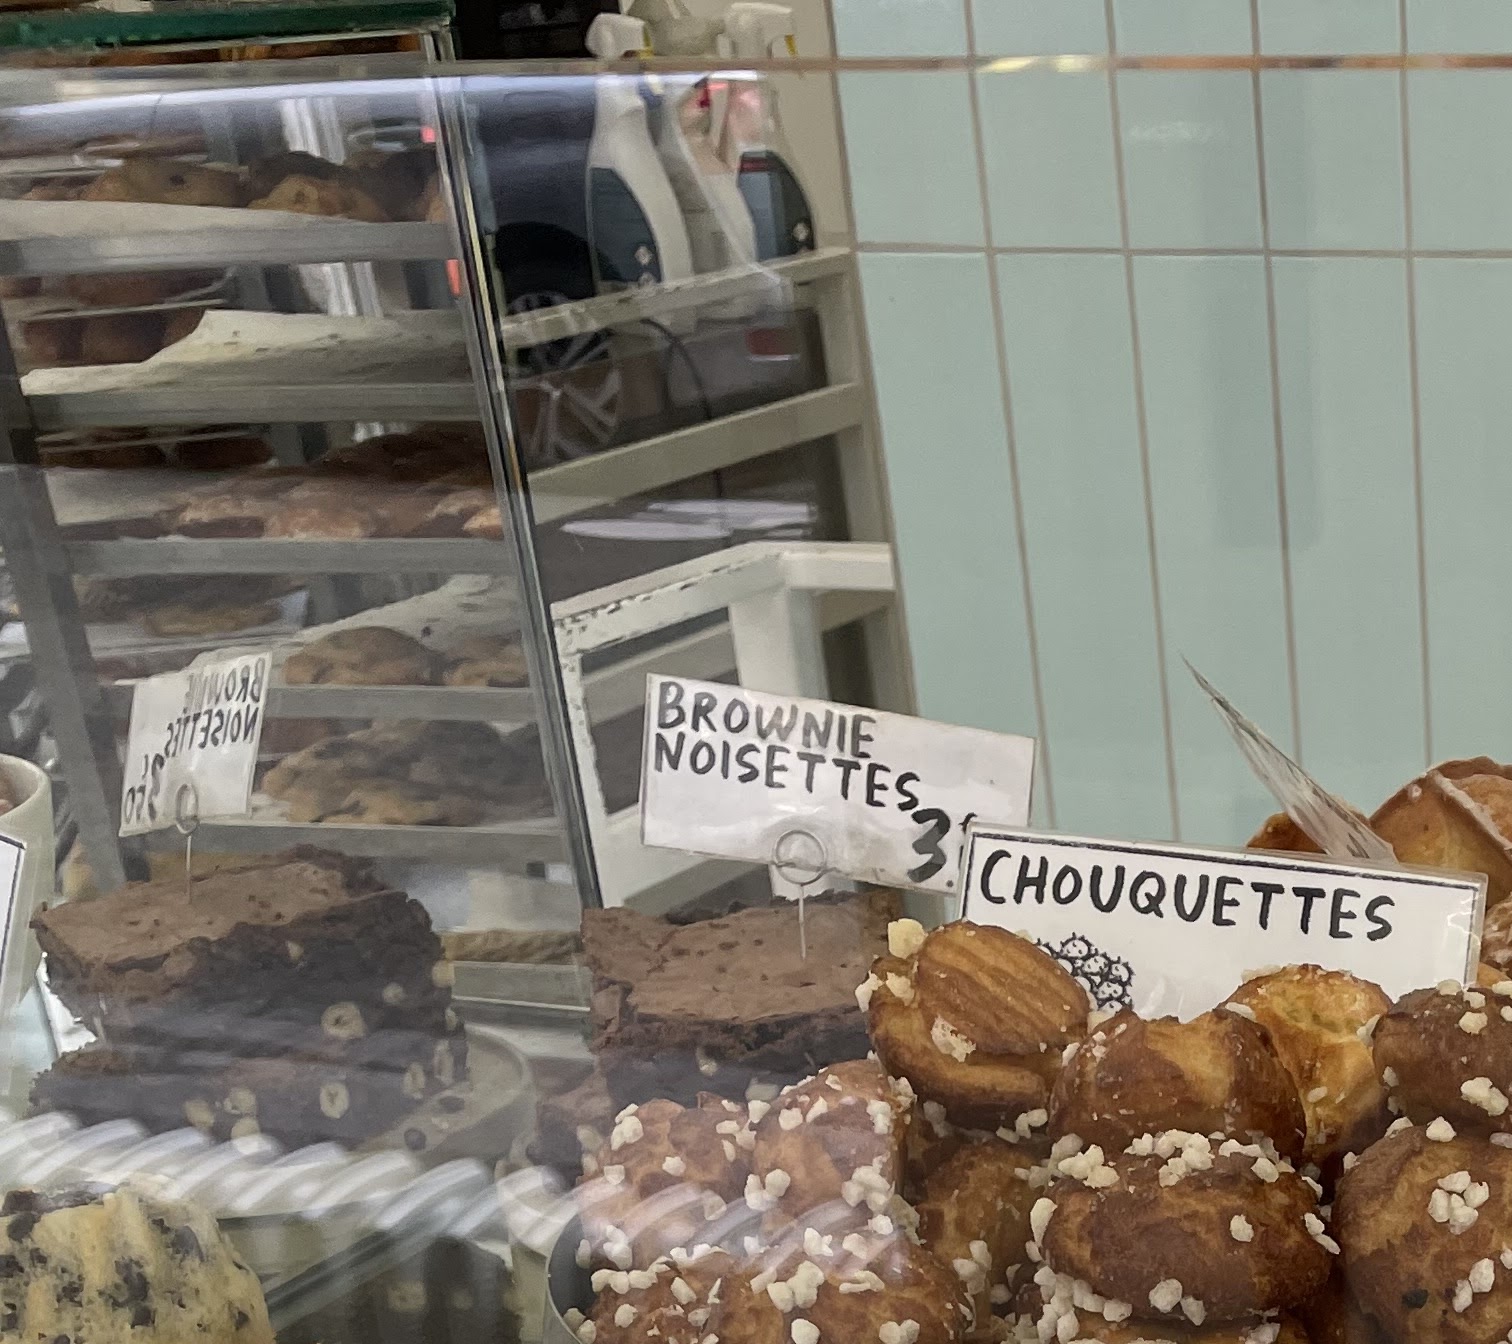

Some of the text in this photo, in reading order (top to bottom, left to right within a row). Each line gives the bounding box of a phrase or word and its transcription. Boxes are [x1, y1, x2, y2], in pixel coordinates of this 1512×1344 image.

[656, 680, 877, 760] BROWNIE
[653, 732, 921, 812] NOISETTES
[980, 849, 1396, 942] CHOUQUETTES
